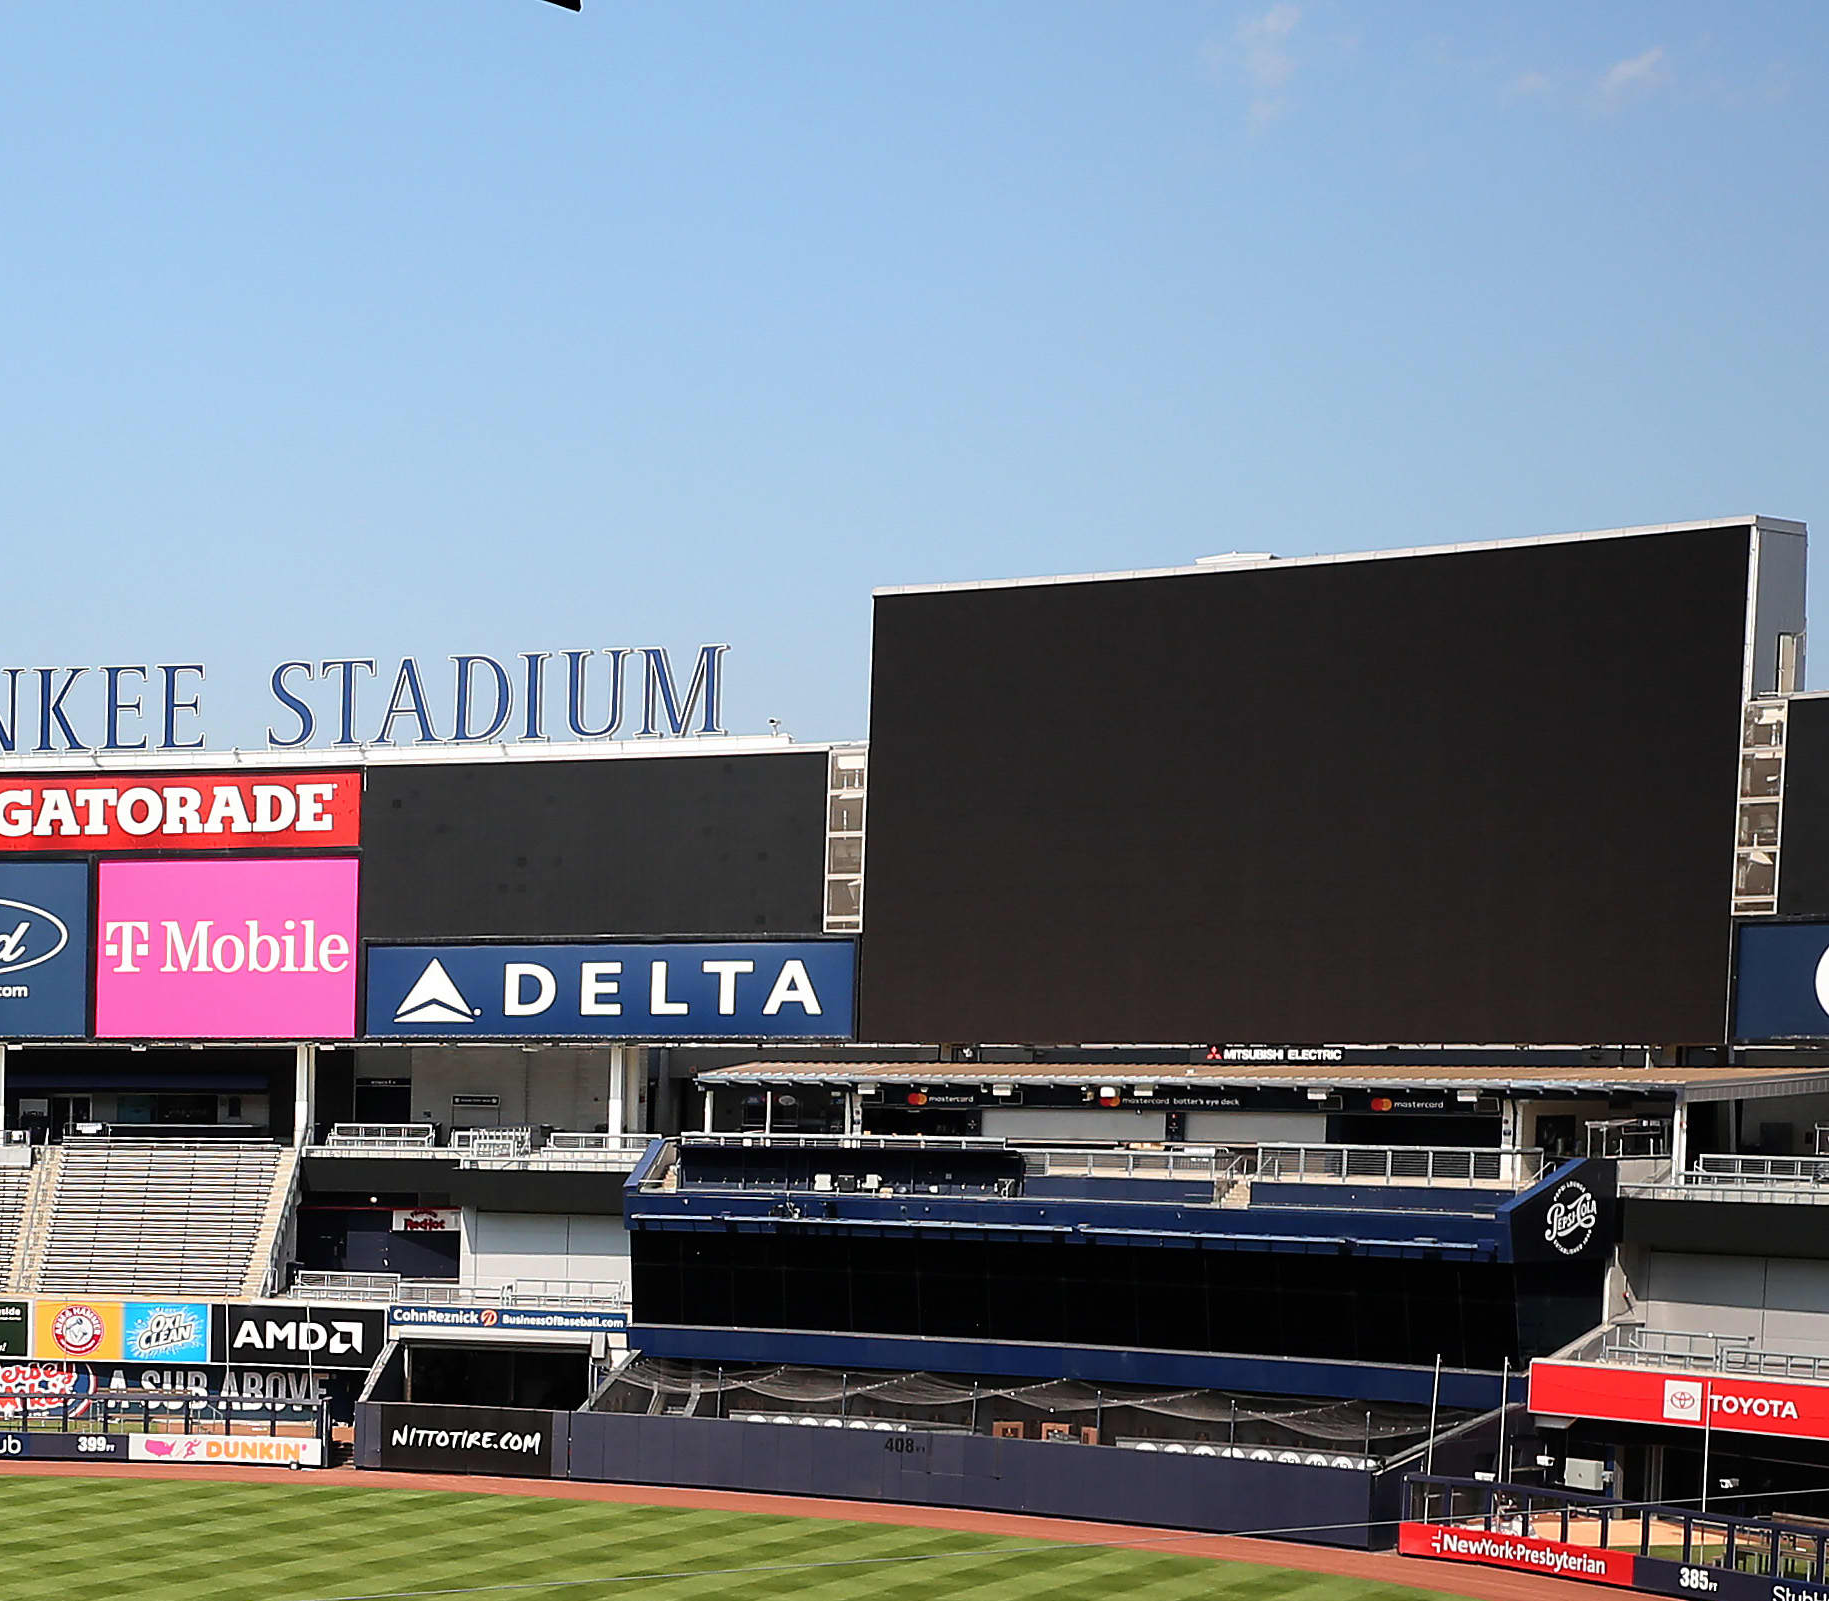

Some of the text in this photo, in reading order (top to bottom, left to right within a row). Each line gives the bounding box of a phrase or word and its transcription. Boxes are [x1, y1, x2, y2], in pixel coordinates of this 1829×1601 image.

[266, 643, 731, 749] STADIUM
[159, 920, 349, 974] Mobile
[503, 957, 824, 1018] DELTA
[1222, 1049, 1343, 1060] MITSUBISHI ELECTRIC
[150, 1314, 182, 1333] OXI
[392, 1310, 625, 1329] CohnReznick BusinessOfBaseball.com
[138, 1324, 194, 1351] CLEAN
[233, 1320, 328, 1351] AMD
[108, 1369, 331, 1412] A SUB ABOVE
[1710, 1395, 1800, 1420] TOYOTA
[205, 1440, 308, 1461] DUNKIN'
[392, 1424, 542, 1455] NITTOTIRE.COM
